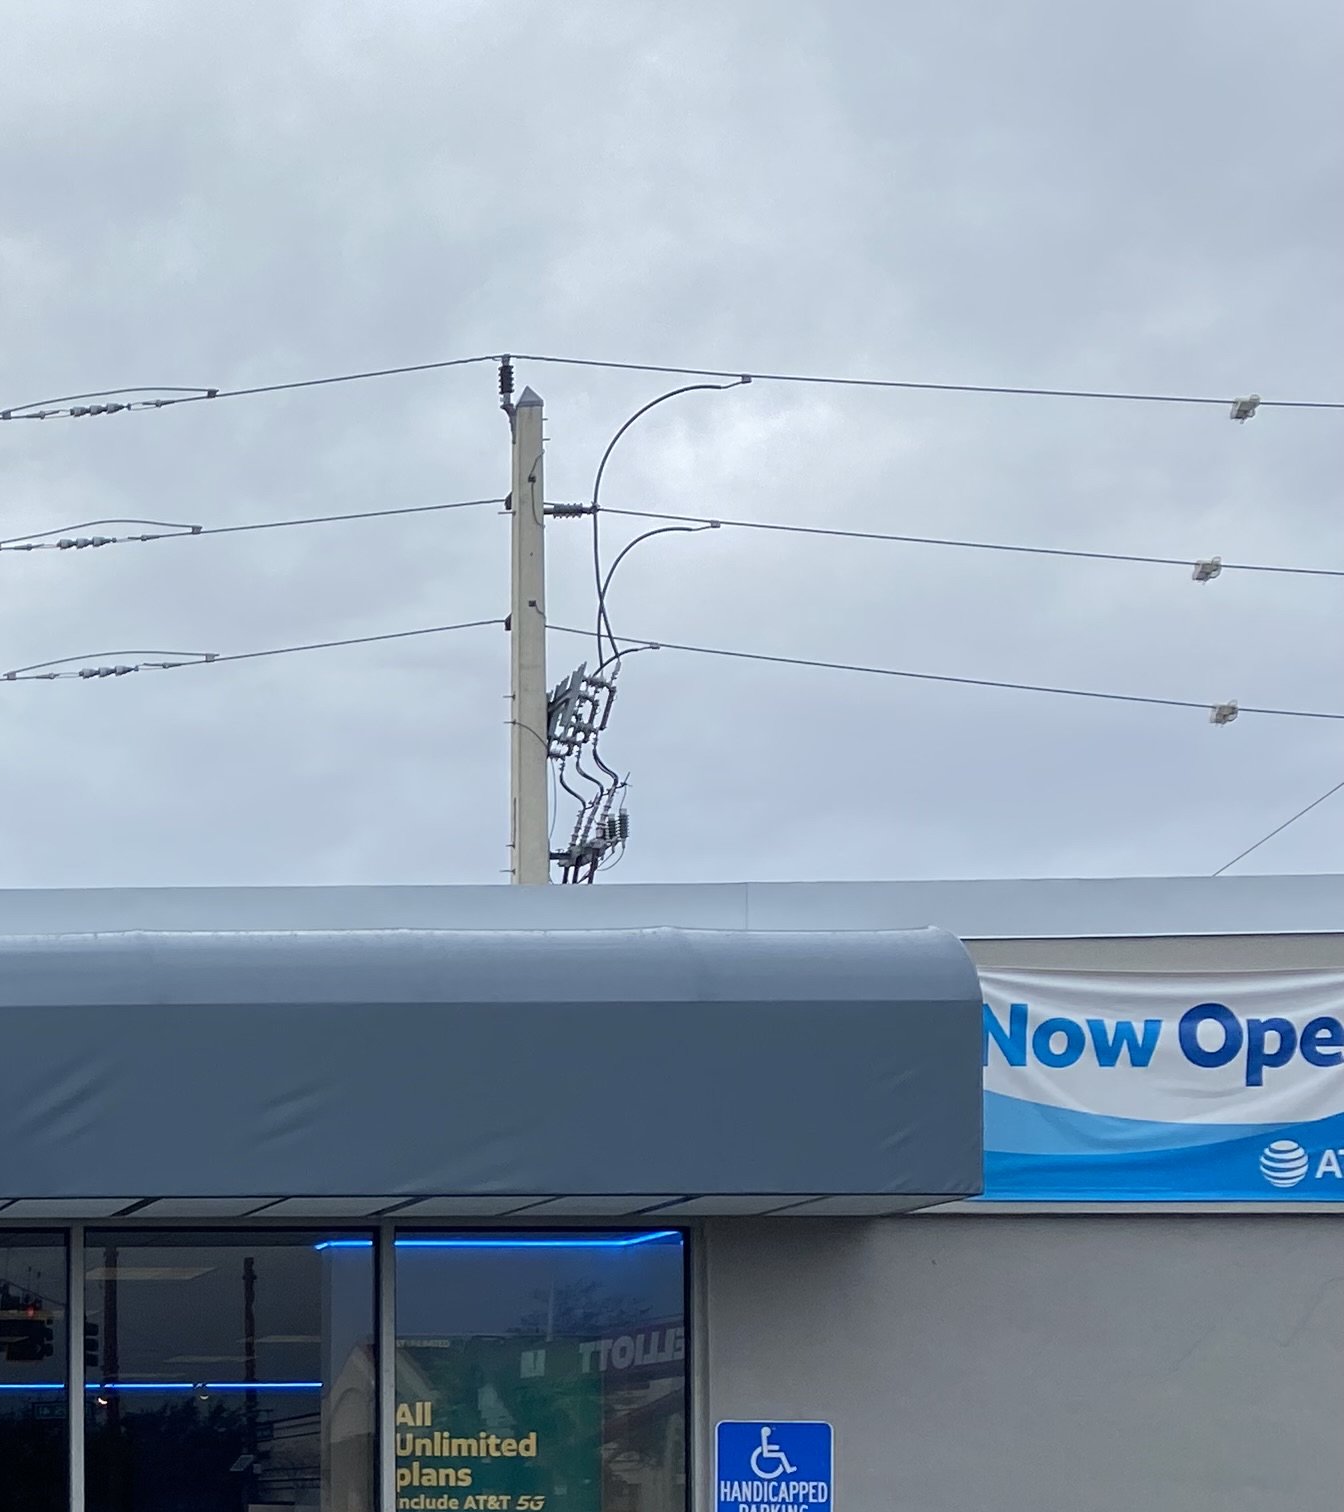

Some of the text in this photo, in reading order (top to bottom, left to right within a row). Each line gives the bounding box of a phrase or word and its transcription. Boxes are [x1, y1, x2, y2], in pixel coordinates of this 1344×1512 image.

[983, 1003, 1163, 1068] Now
[396, 1401, 432, 1427] All
[396, 1432, 537, 1457] Unlimited
[397, 1461, 472, 1493] plans
[464, 1495, 511, 1510] AT&T
[515, 1495, 545, 1511] 5G
[720, 1480, 828, 1503] HANDICAPPED
